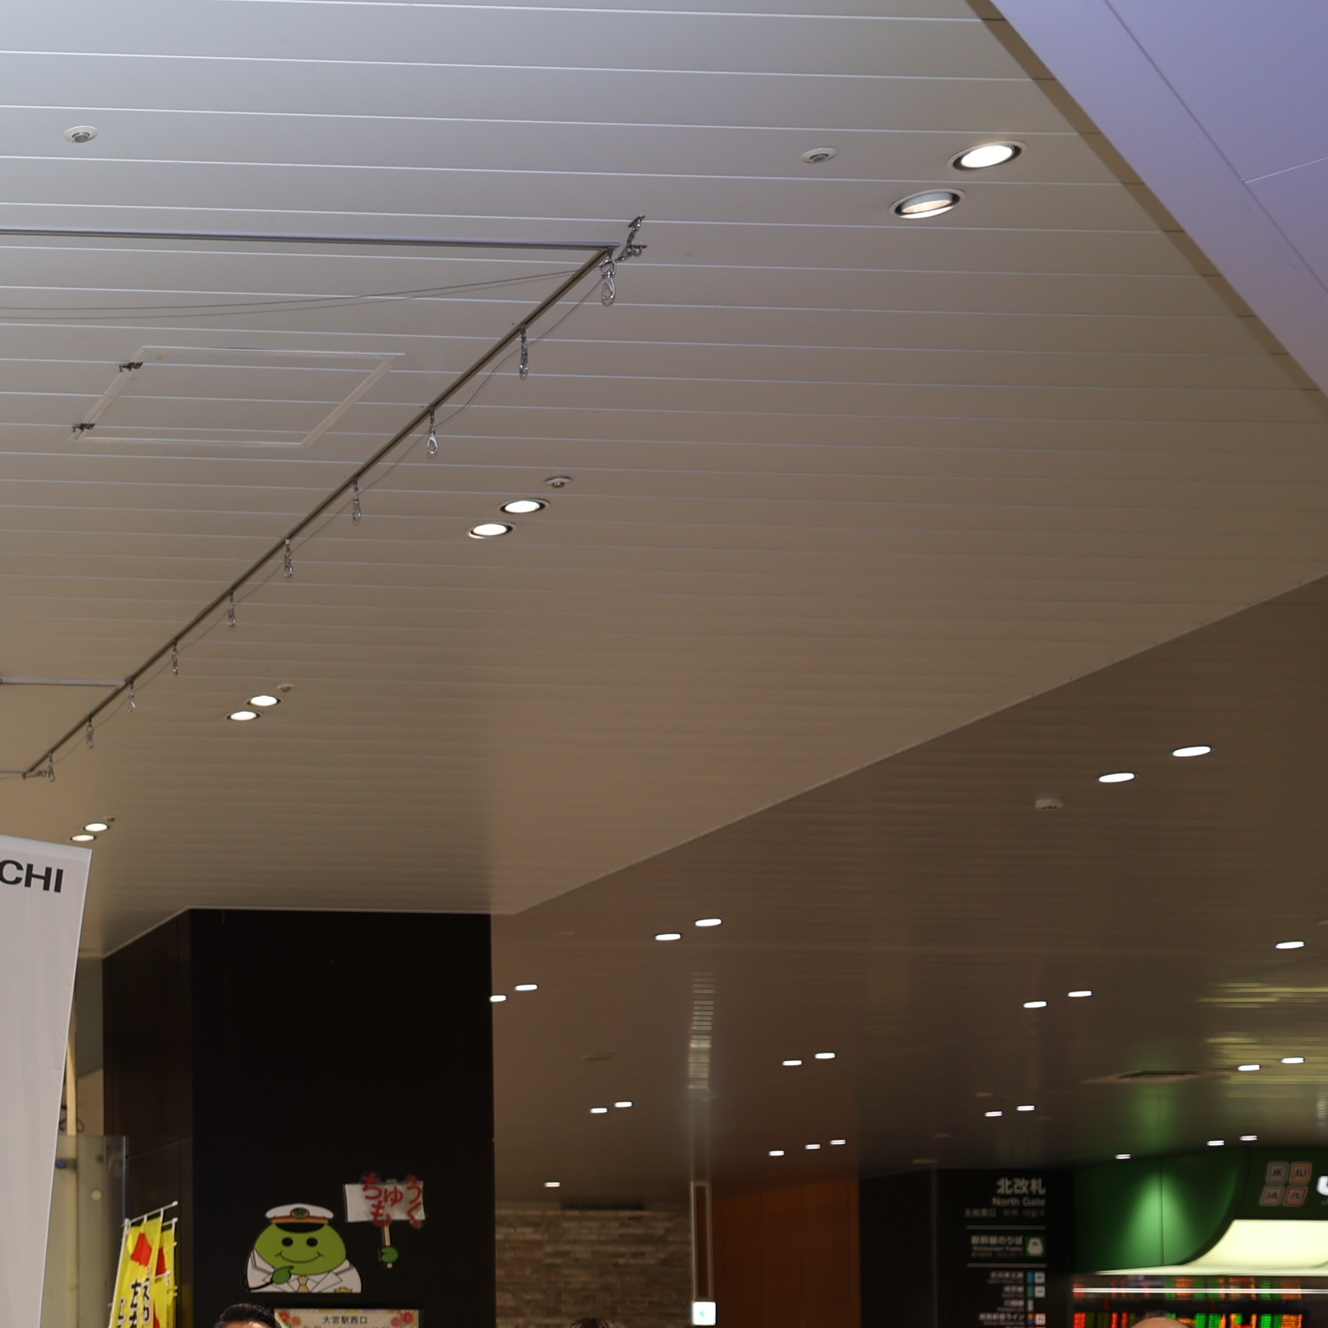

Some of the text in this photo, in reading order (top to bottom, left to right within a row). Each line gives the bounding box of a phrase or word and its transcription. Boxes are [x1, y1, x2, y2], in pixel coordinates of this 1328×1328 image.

[996, 1177, 1046, 1196] 北改札
[322, 1315, 368, 1325] 大宮駅西口
